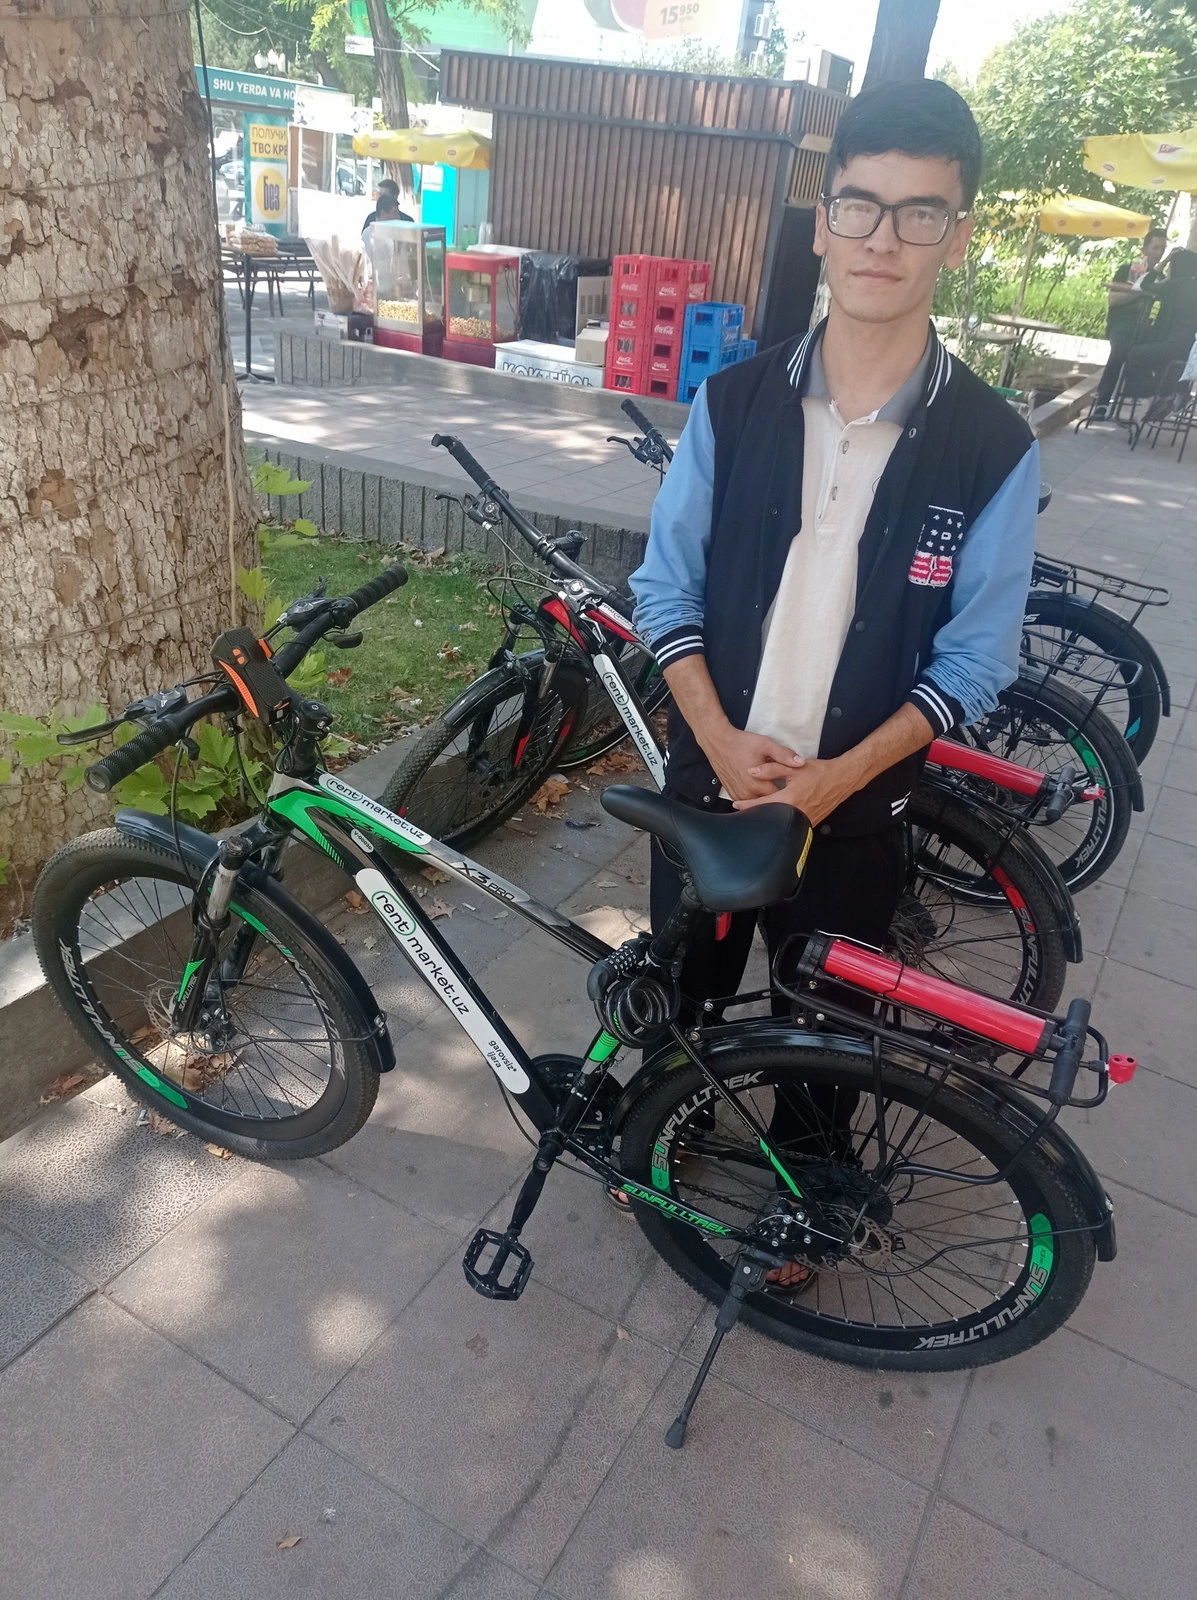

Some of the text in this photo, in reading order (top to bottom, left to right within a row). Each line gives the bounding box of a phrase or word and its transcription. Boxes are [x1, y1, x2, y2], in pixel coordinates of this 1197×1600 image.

[213, 78, 234, 92] SHU
[237, 82, 268, 97] YERDA
[269, 86, 281, 99] VA
[604, 673, 658, 766] rent market.uz
[329, 780, 425, 840] rent market.uz
[457, 861, 515, 901] X3 PRO
[376, 894, 470, 1015] rent market.uz
[487, 1051, 502, 1068] ijara
[620, 1183, 732, 1236] SUNFULLTREK
[913, 1263, 1048, 1350] SUNFULLTREK
